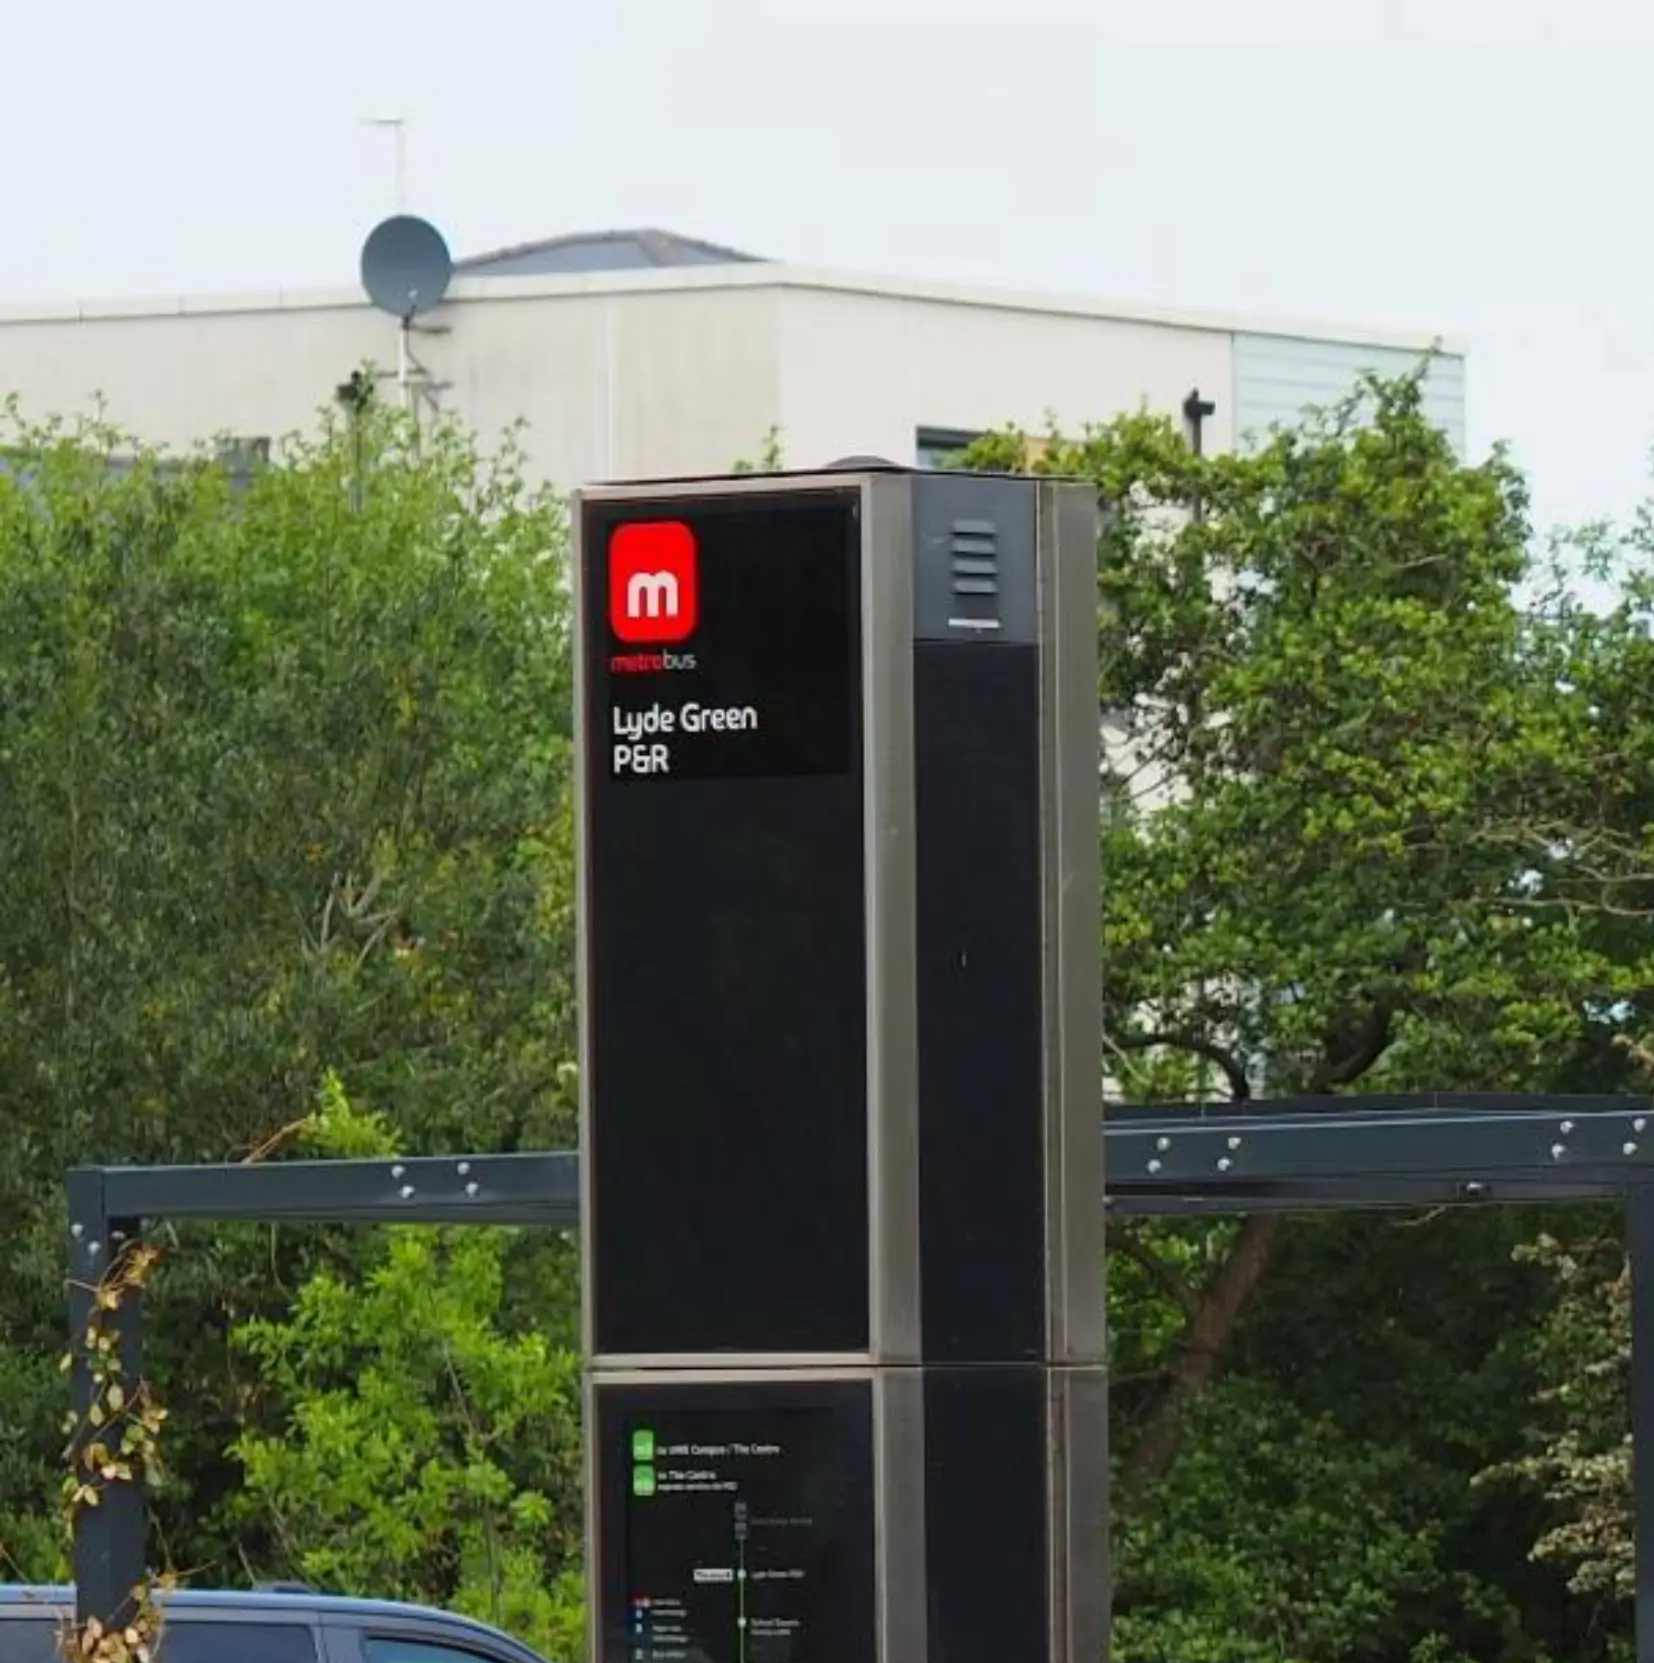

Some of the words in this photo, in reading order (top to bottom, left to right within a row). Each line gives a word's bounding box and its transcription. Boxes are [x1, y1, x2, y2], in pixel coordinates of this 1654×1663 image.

[627, 570, 679, 618] m
[611, 649, 697, 673] metrobus
[613, 703, 675, 741] Lyde
[680, 702, 758, 732] Green
[613, 744, 670, 774] P&R
